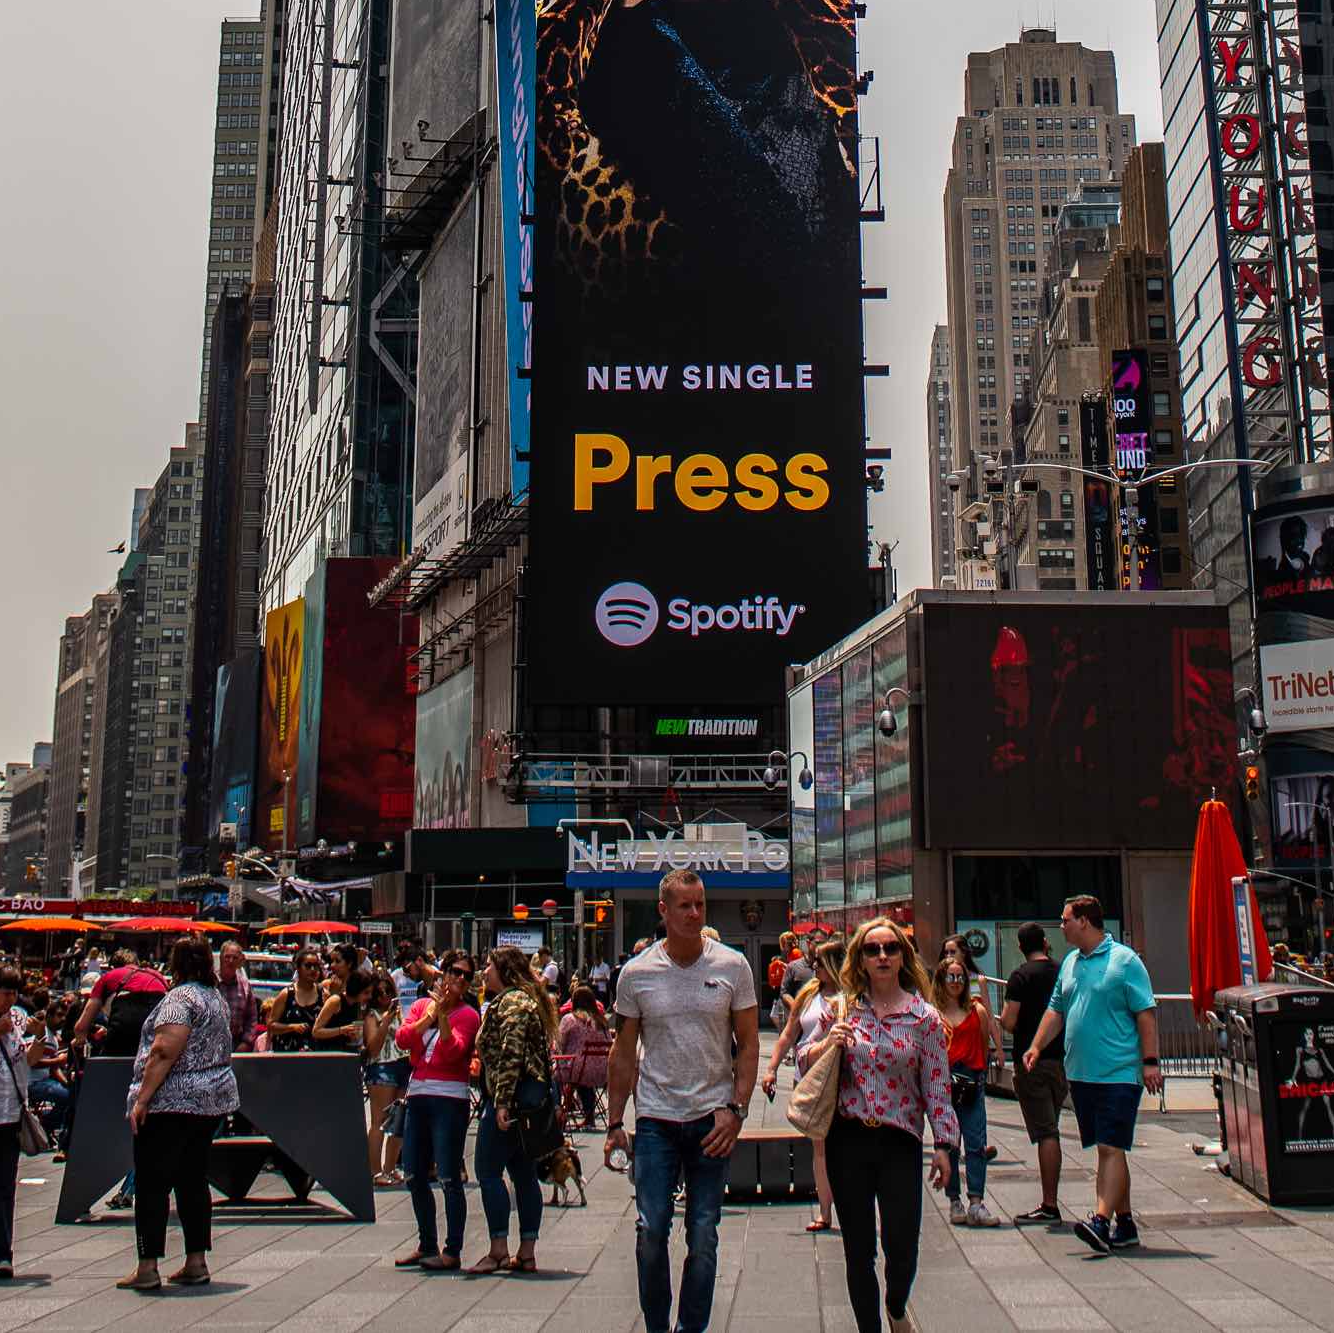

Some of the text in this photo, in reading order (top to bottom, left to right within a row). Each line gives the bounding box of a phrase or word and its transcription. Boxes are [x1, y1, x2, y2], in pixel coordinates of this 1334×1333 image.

[1217, 39, 1282, 388] YOUNG
[587, 364, 813, 391] NEW SINGLE
[574, 433, 830, 511] Press
[1263, 578, 1306, 599] PEOPLE
[1306, 704, 1324, 714] starts
[11, 898, 45, 911] BAO
